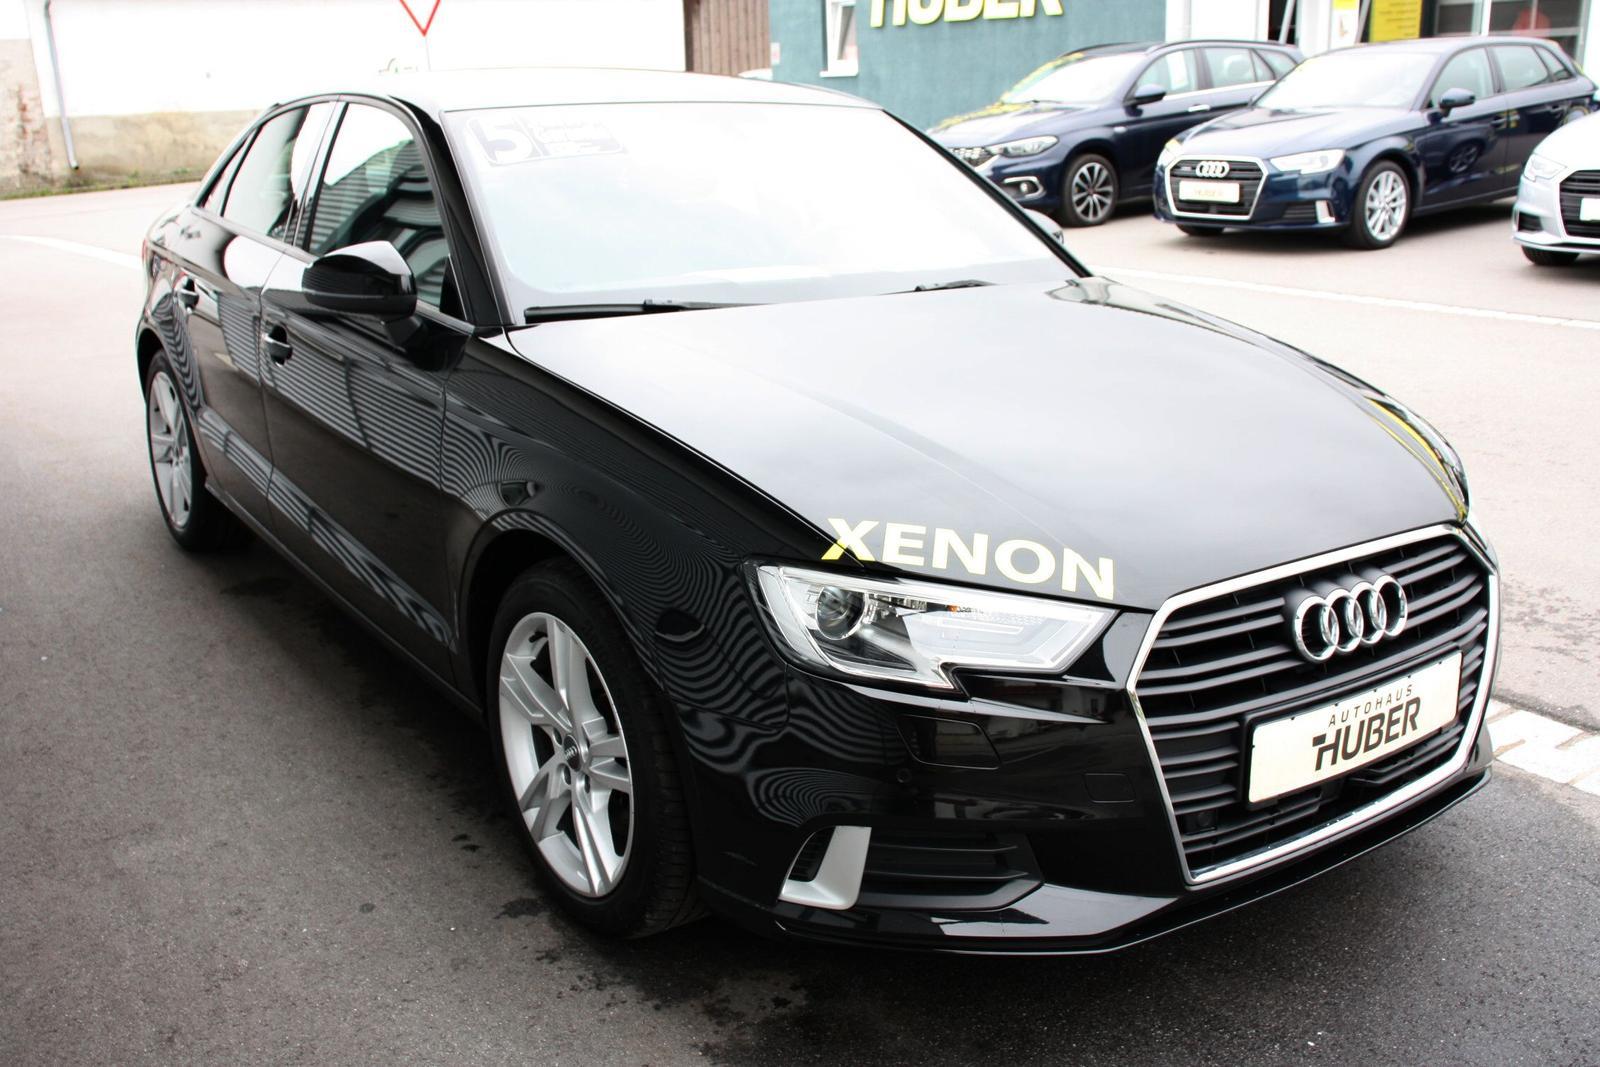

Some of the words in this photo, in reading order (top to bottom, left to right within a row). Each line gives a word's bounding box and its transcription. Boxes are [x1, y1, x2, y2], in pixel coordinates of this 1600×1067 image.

[821, 518, 1114, 600] XENON
[1312, 696, 1420, 771] HUBER
[1329, 684, 1412, 727] AUTOHAUS
